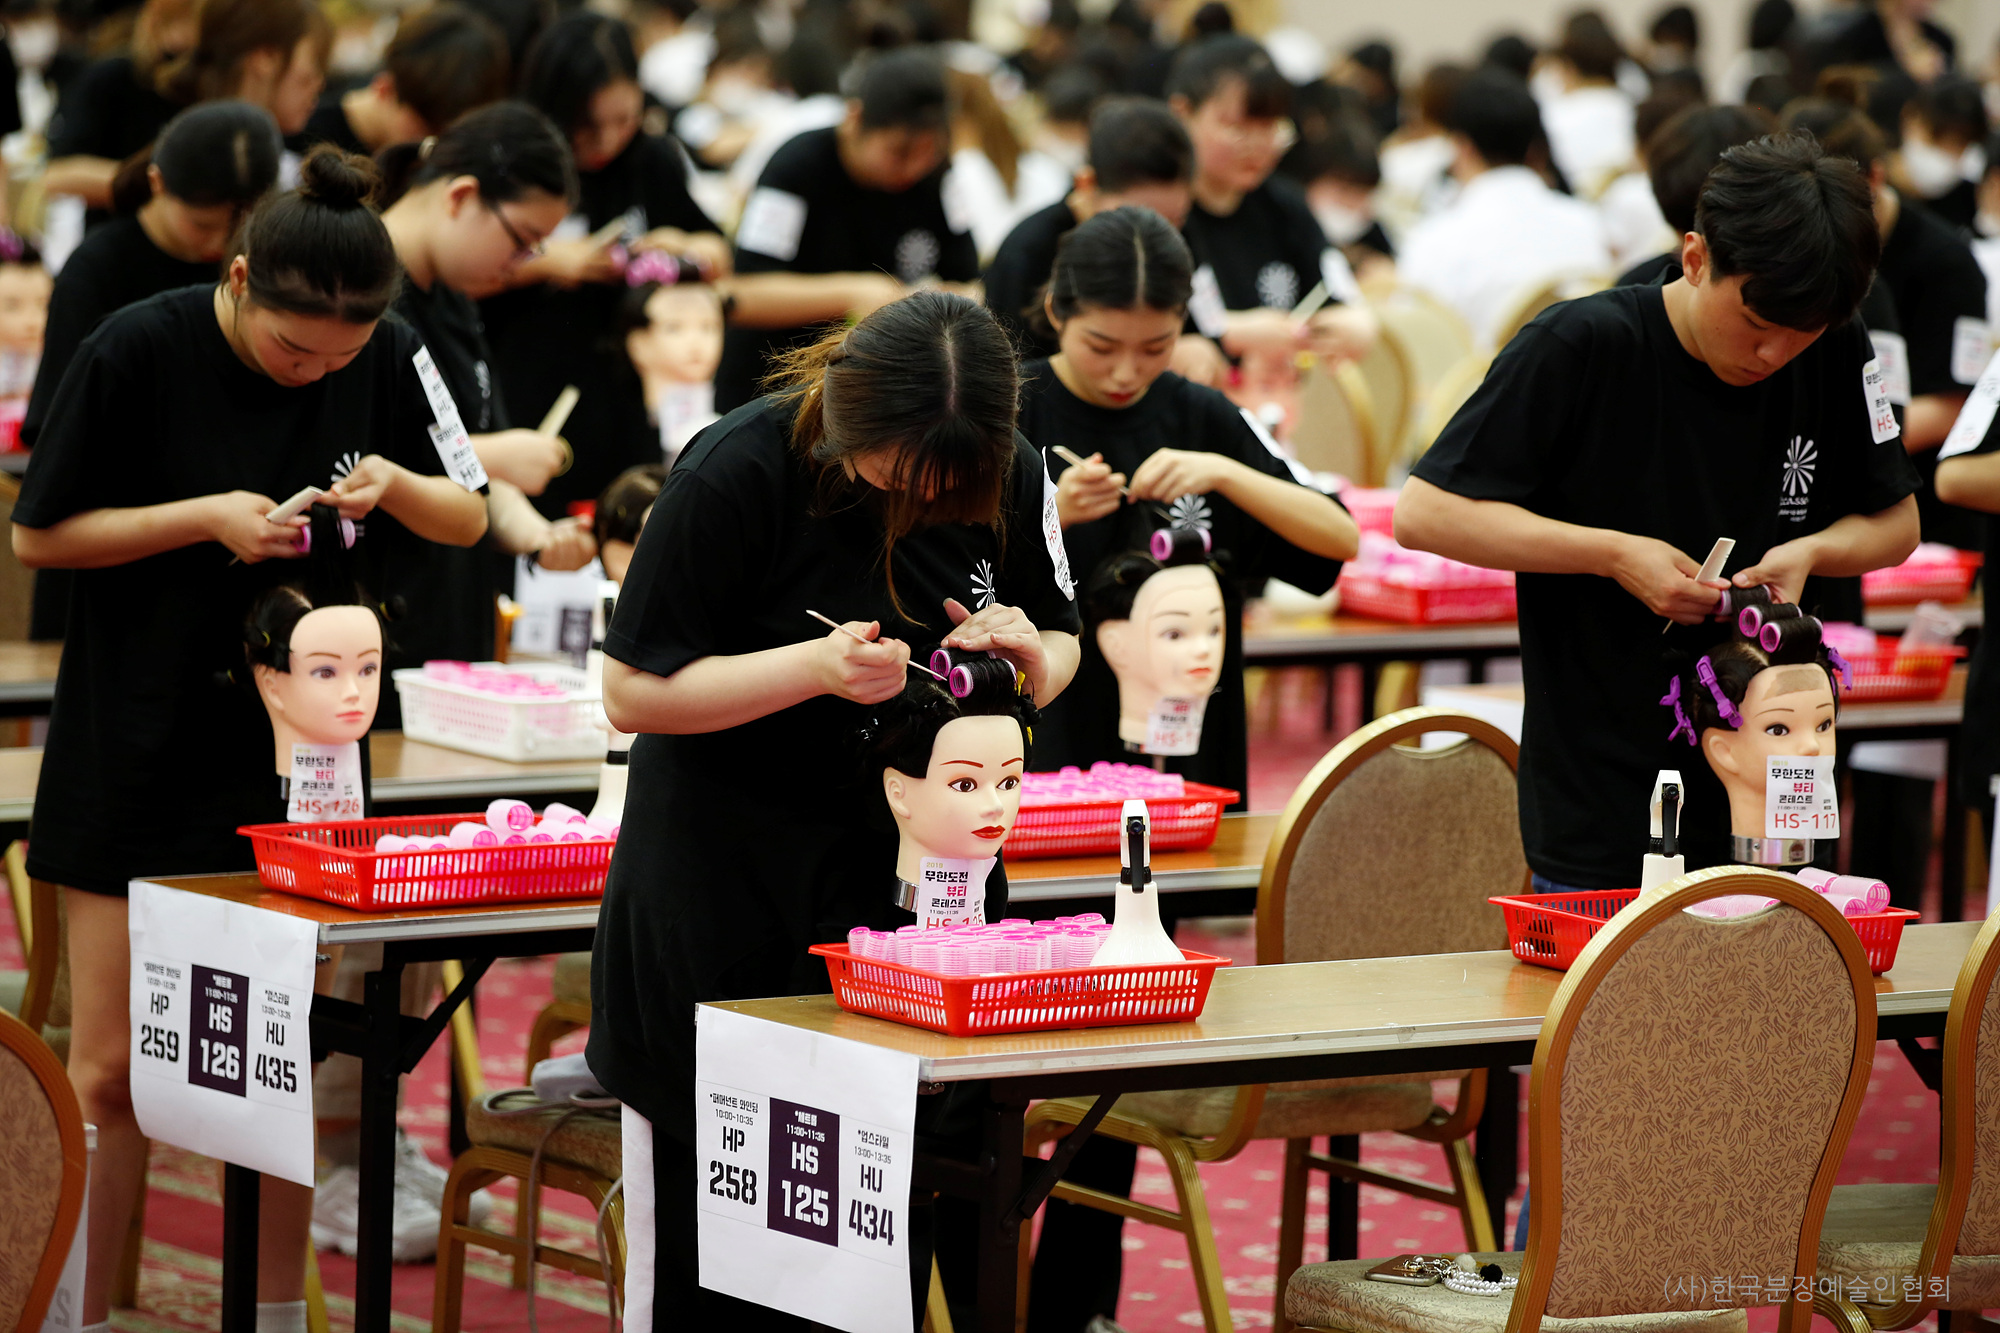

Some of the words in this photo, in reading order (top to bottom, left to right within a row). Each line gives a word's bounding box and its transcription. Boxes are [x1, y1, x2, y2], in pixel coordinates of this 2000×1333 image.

[1771, 768, 1815, 780] 무한도전
[1793, 782, 1814, 793] 뷰티
[297, 798, 360, 815] HS-126
[1779, 794, 1813, 804] 콘테스트
[1774, 813, 1837, 829] HS-117
[925, 870, 969, 883] 무한도전
[946, 885, 967, 897] 뷰티
[931, 898, 966, 908] 콘테스트
[150, 992, 170, 1016] HP
[208, 1002, 233, 1034] HS
[141, 1023, 179, 1062] 259
[265, 1020, 285, 1046] HU
[200, 1038, 240, 1081] 126
[255, 1053, 297, 1093] 435
[715, 1108, 754, 1126] 10:00~10:35
[739, 1099, 759, 1114] 와인딩
[722, 1125, 745, 1153] HP
[786, 1124, 826, 1142] 11:00~11:35
[791, 1141, 819, 1175] HS
[854, 1146, 892, 1164] 13:00~13:35
[709, 1160, 757, 1205] 258
[860, 1163, 883, 1193] HU
[781, 1179, 829, 1227] 125
[848, 1199, 895, 1246] 434
